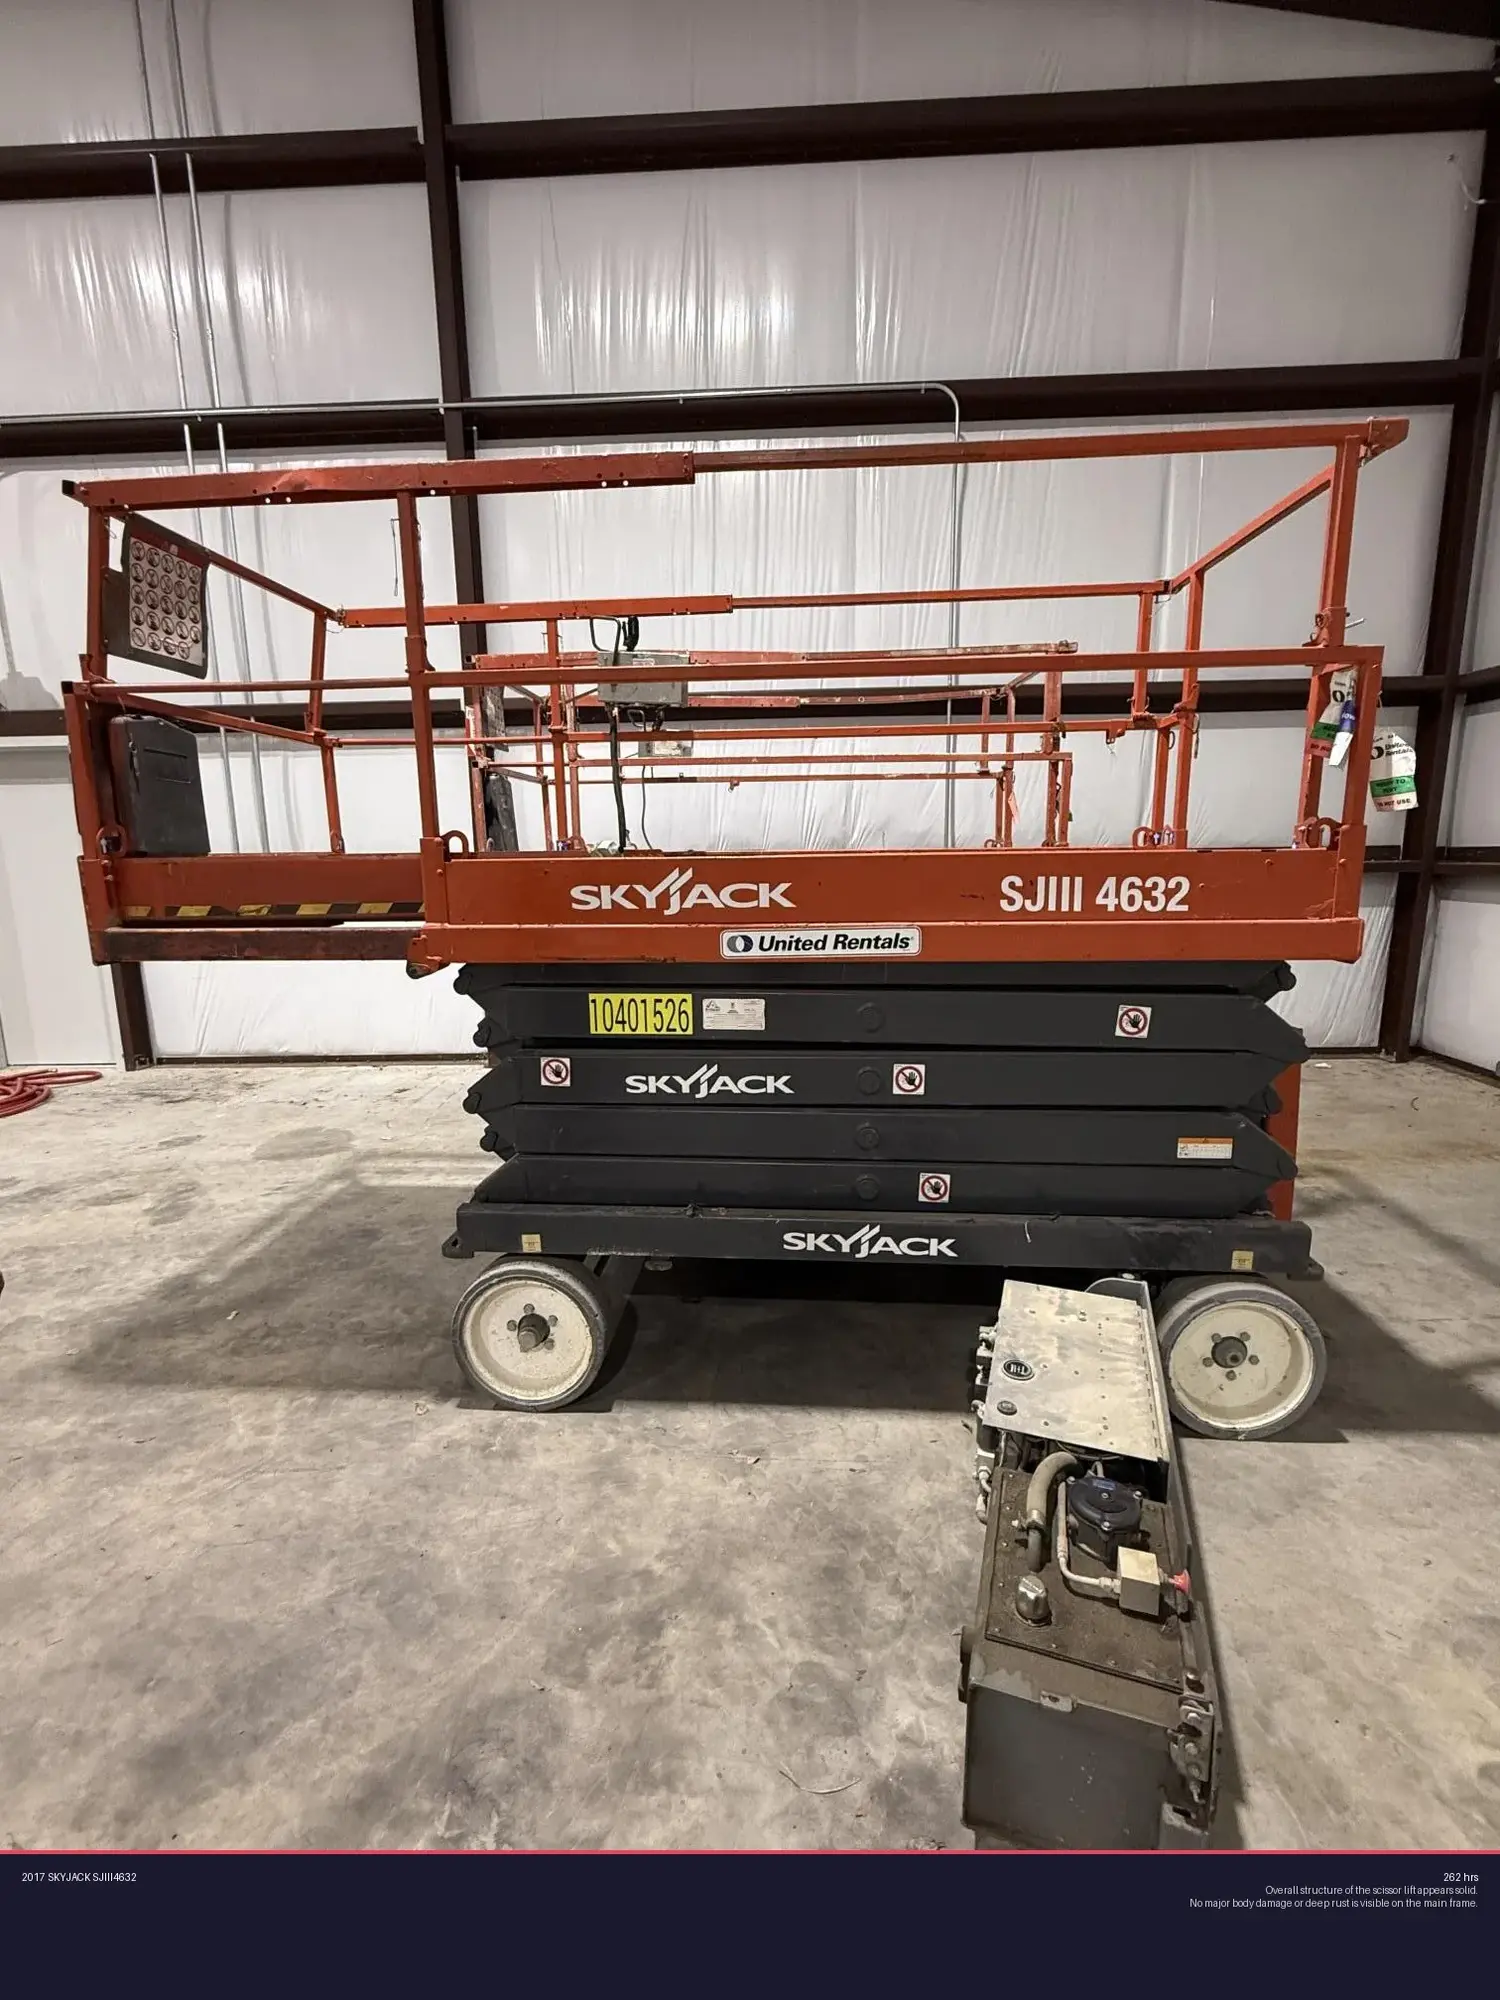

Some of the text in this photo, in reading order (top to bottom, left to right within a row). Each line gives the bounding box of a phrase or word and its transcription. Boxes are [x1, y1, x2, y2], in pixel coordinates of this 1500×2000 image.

[570, 867, 796, 915] SKYJACK
[1000, 875, 1190, 912] SJIII 4632
[758, 931, 828, 952] United
[590, 996, 691, 1034] 10401526
[625, 1063, 795, 1099] SKYJACK
[782, 1224, 957, 1259] SKYJACK
